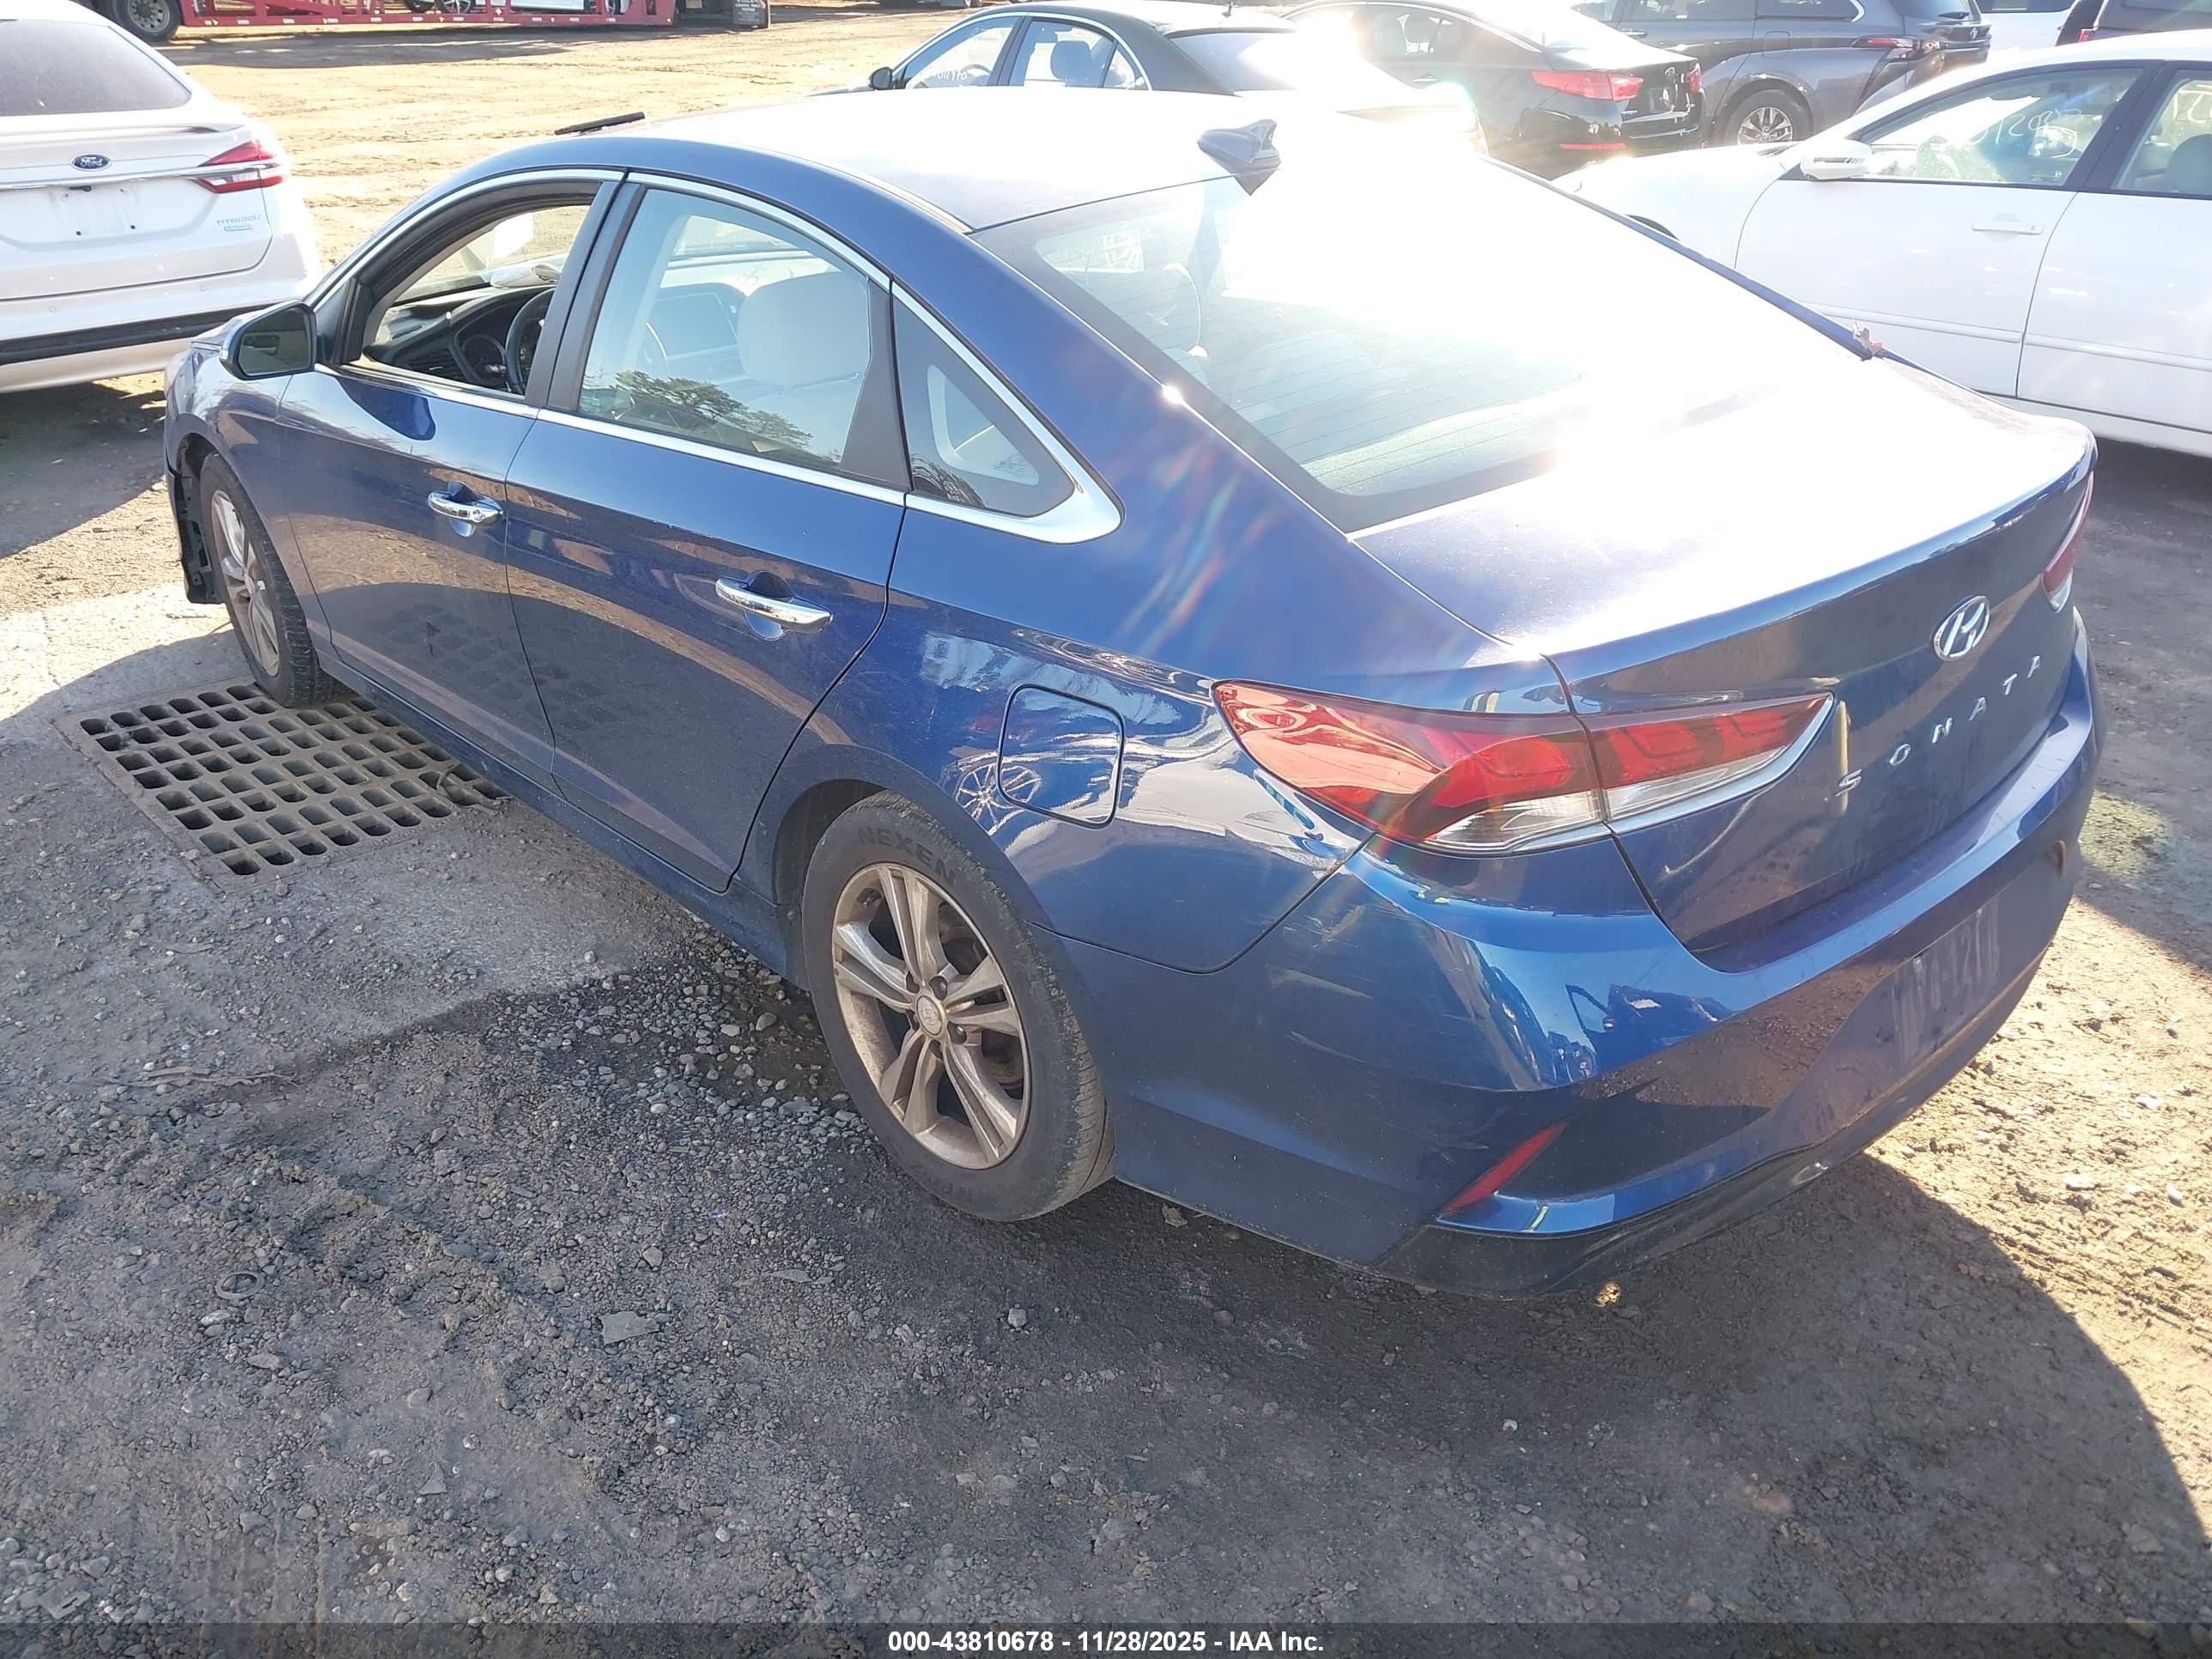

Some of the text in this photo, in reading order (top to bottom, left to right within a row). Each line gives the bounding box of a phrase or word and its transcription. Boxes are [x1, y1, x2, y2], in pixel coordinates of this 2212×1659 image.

[80, 156, 104, 167] Ford
[1834, 655, 2042, 797] SONATA
[858, 827, 956, 888] NEXEN
